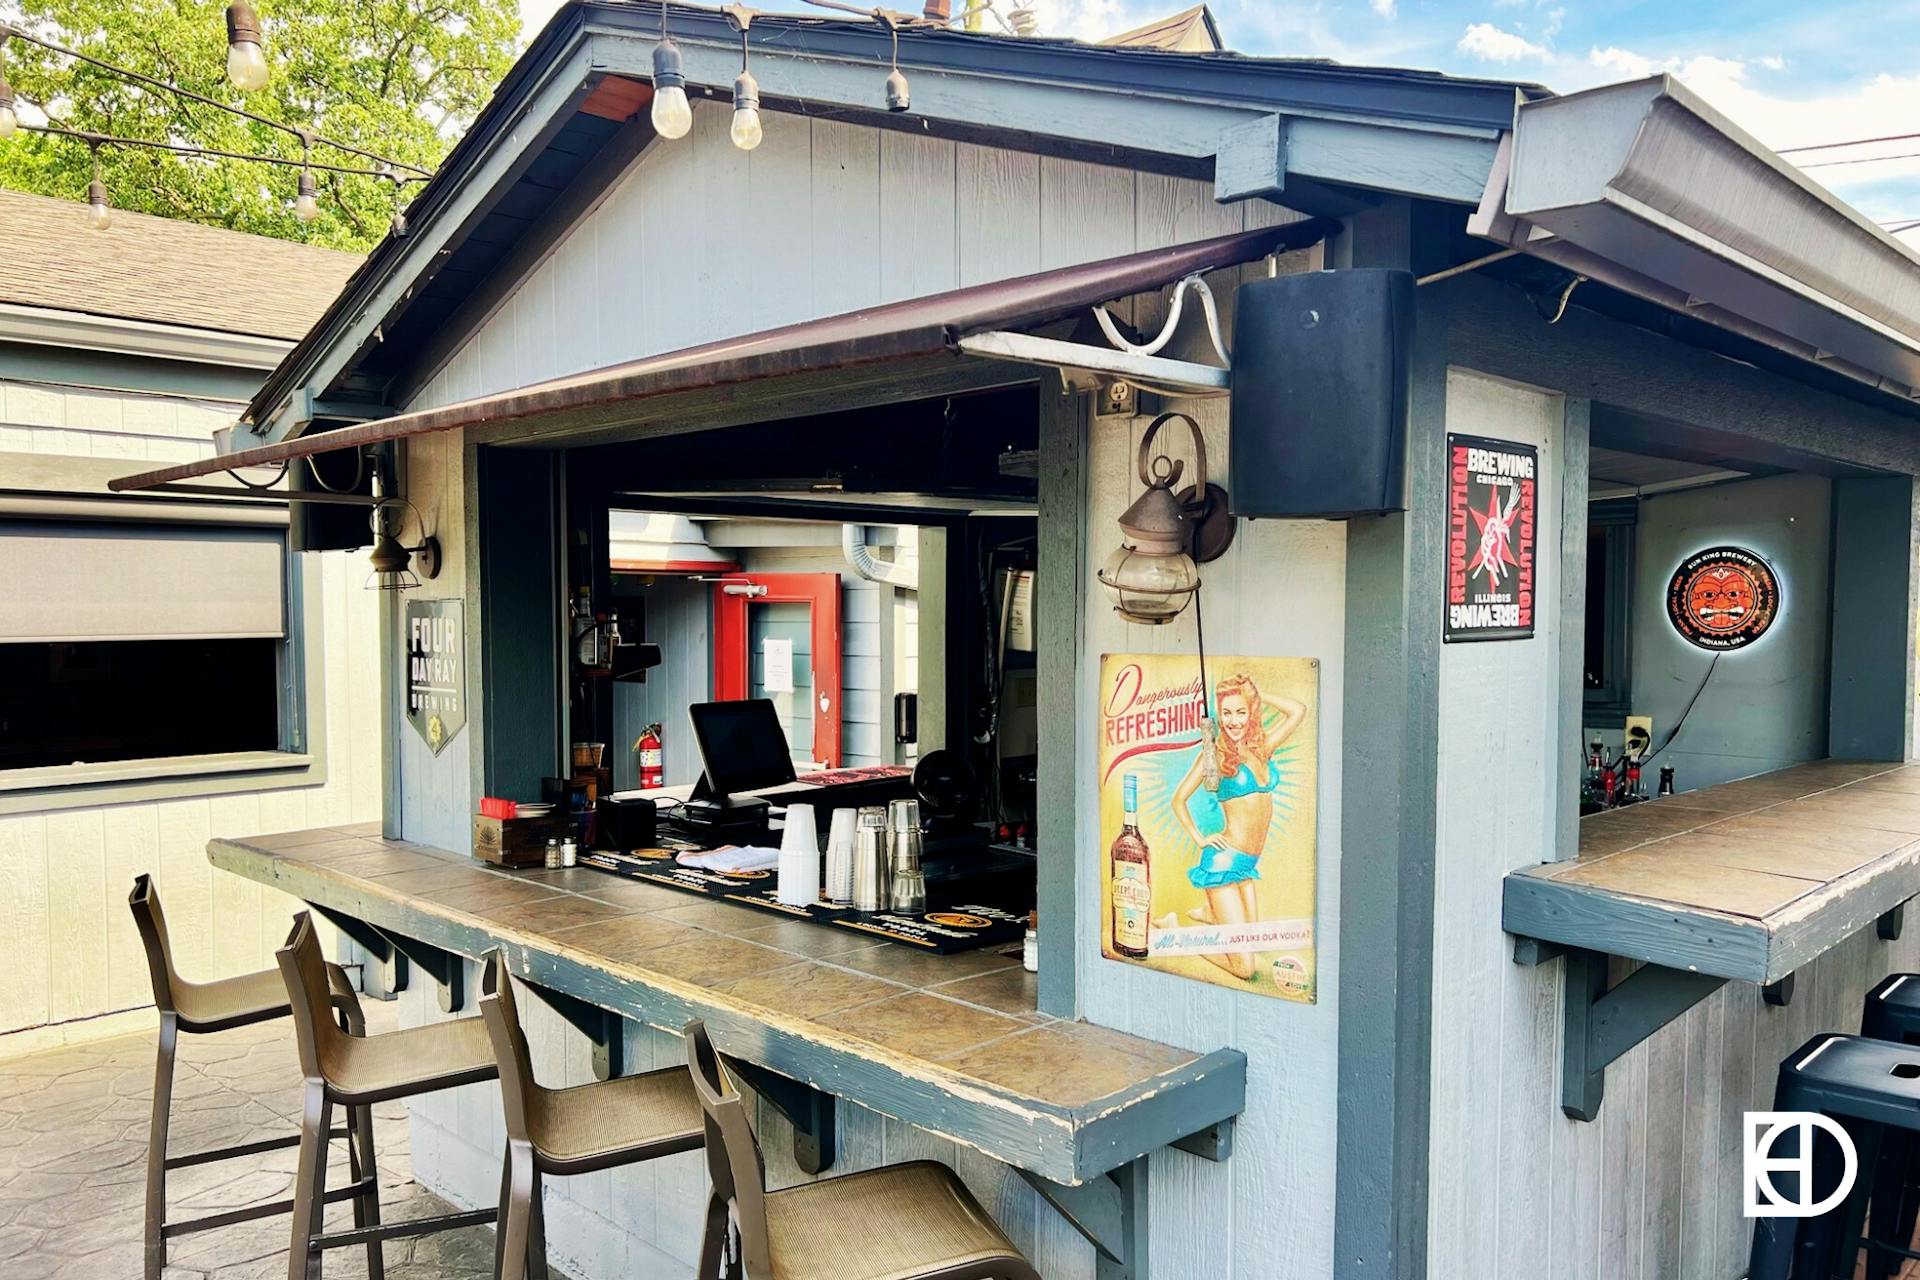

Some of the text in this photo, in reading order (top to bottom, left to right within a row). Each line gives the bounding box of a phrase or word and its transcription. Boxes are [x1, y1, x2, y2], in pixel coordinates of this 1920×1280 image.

[1468, 448, 1534, 479] BREWING
[1476, 475, 1514, 487] CHICAGO
[1451, 446, 1469, 604] REVOLUTION
[1519, 479, 1534, 628] REVOLUTION
[1687, 551, 1758, 570] SUN KING BREWERY
[1474, 593, 1512, 604] ILLINOIS
[1450, 604, 1520, 629] BREWING
[411, 617, 456, 654] FOUR
[1731, 636, 1747, 646] USA
[434, 658, 457, 683] RAY
[411, 693, 457, 713] BREWING
[1104, 664, 1204, 718] Dangerously
[1230, 935, 1244, 944] JUST
[1246, 934, 1260, 943] LIKE
[1262, 933, 1278, 941] OUR
